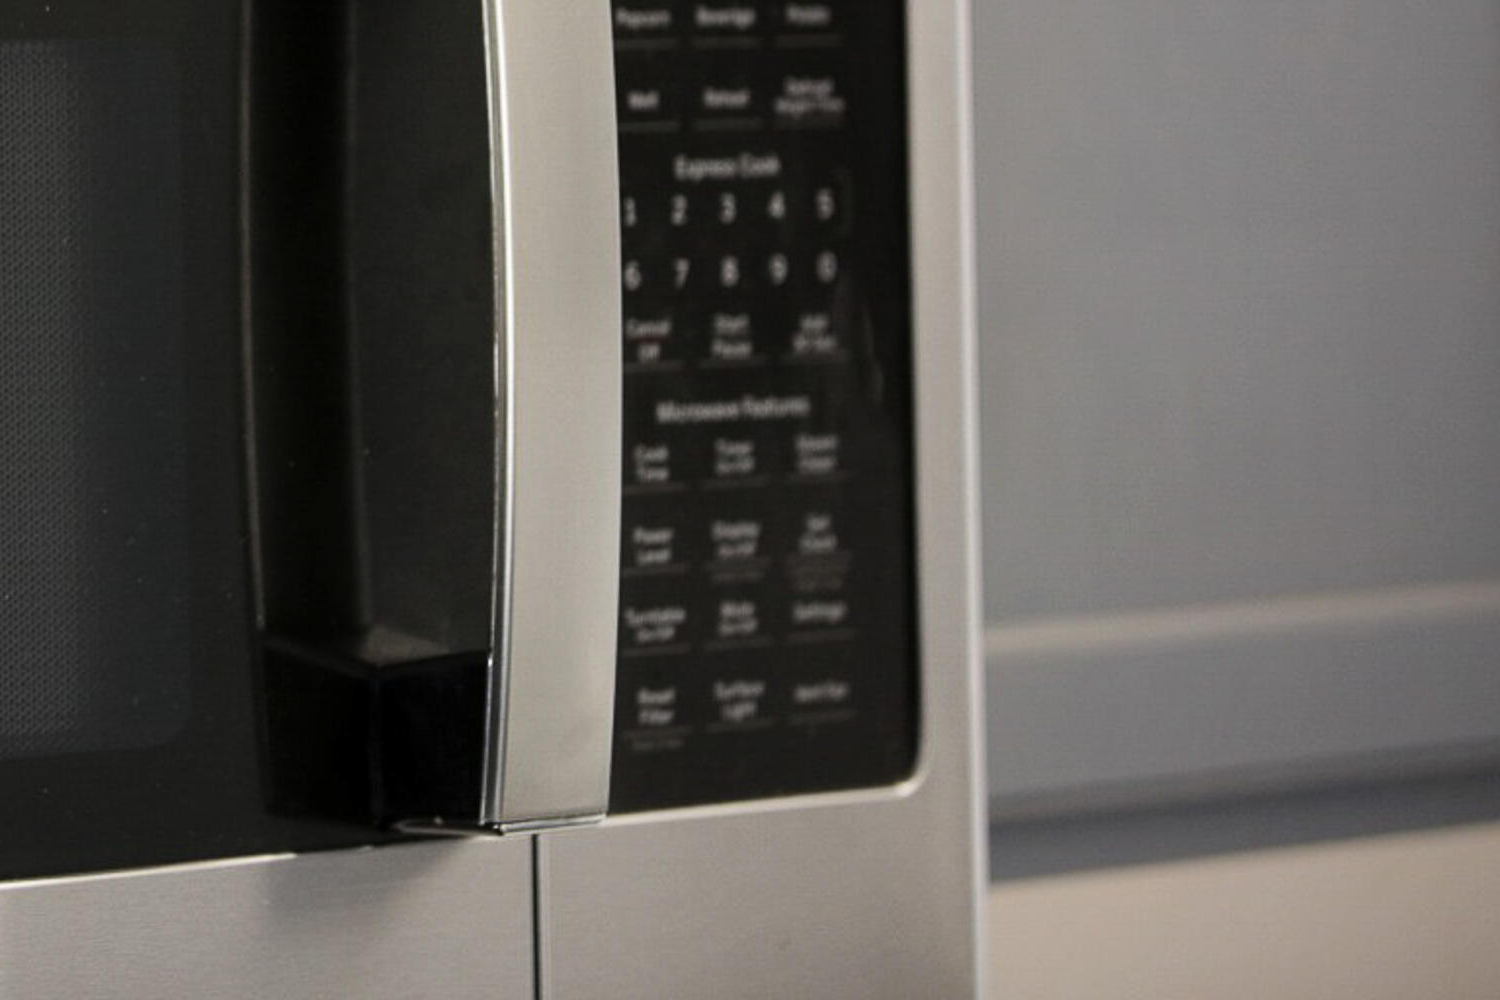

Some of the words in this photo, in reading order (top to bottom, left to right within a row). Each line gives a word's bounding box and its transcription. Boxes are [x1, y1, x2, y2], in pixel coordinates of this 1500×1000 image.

[625, 197, 636, 227] 1
[672, 194, 687, 226] 2
[721, 193, 736, 224] 3
[768, 191, 785, 219] 4
[816, 189, 834, 220] 5
[624, 261, 641, 291] 6
[675, 258, 690, 287] 7
[721, 256, 739, 287] 8
[769, 253, 788, 285] 9
[817, 252, 837, 282] 0
[656, 401, 740, 423] Microwave
